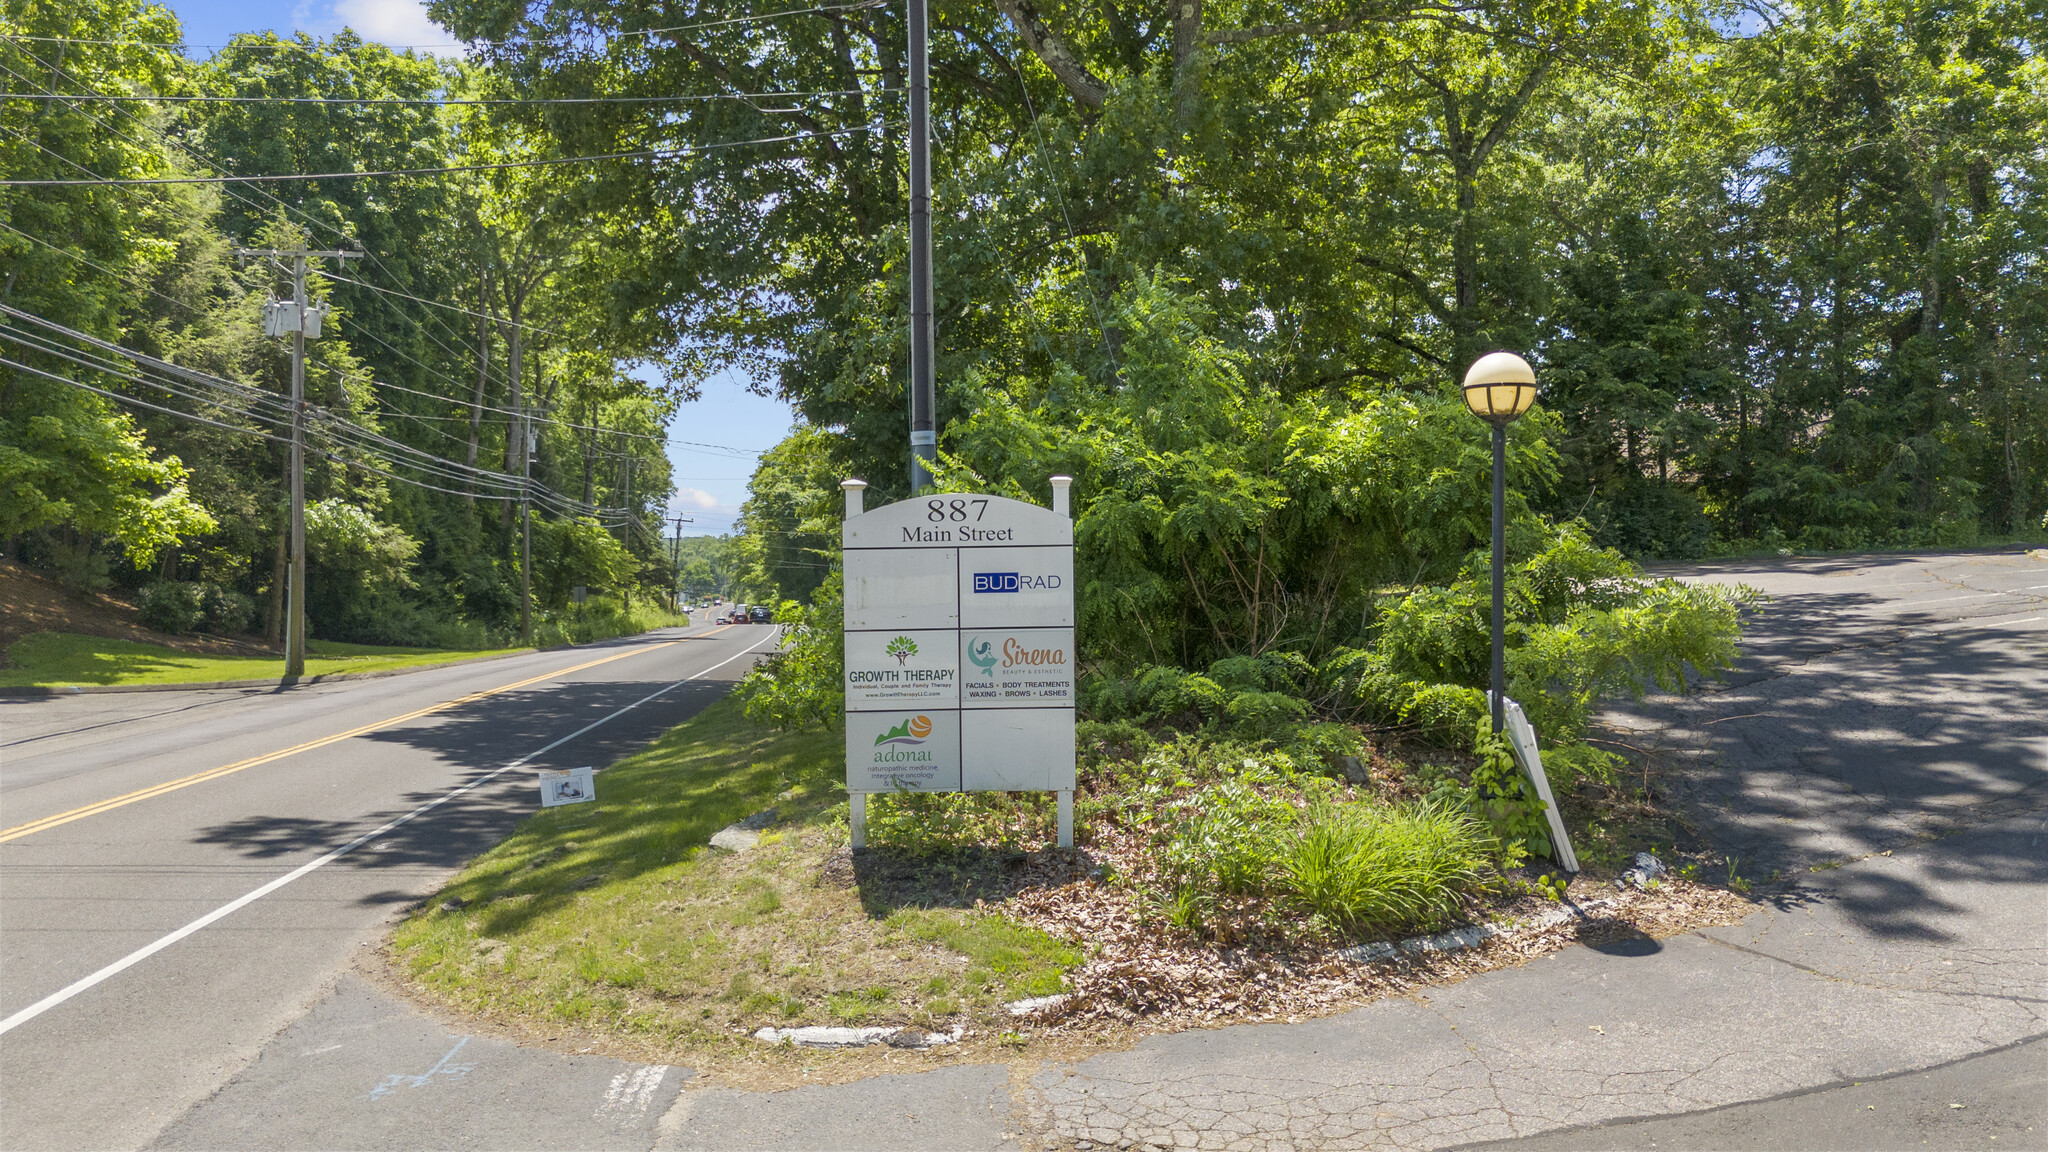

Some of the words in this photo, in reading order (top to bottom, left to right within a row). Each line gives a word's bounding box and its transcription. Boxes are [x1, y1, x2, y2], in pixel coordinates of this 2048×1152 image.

[927, 499, 989, 522] 887
[902, 526, 951, 543] Main
[959, 525, 1014, 542] Street
[975, 575, 1062, 590] BUDRAD
[1002, 637, 1067, 668] Sirena
[849, 670, 899, 682] GROWTH
[904, 669, 955, 681] THERAPY
[873, 744, 933, 763] adonai
[867, 765, 908, 773] naturopathic
[871, 772, 905, 780] integrave
